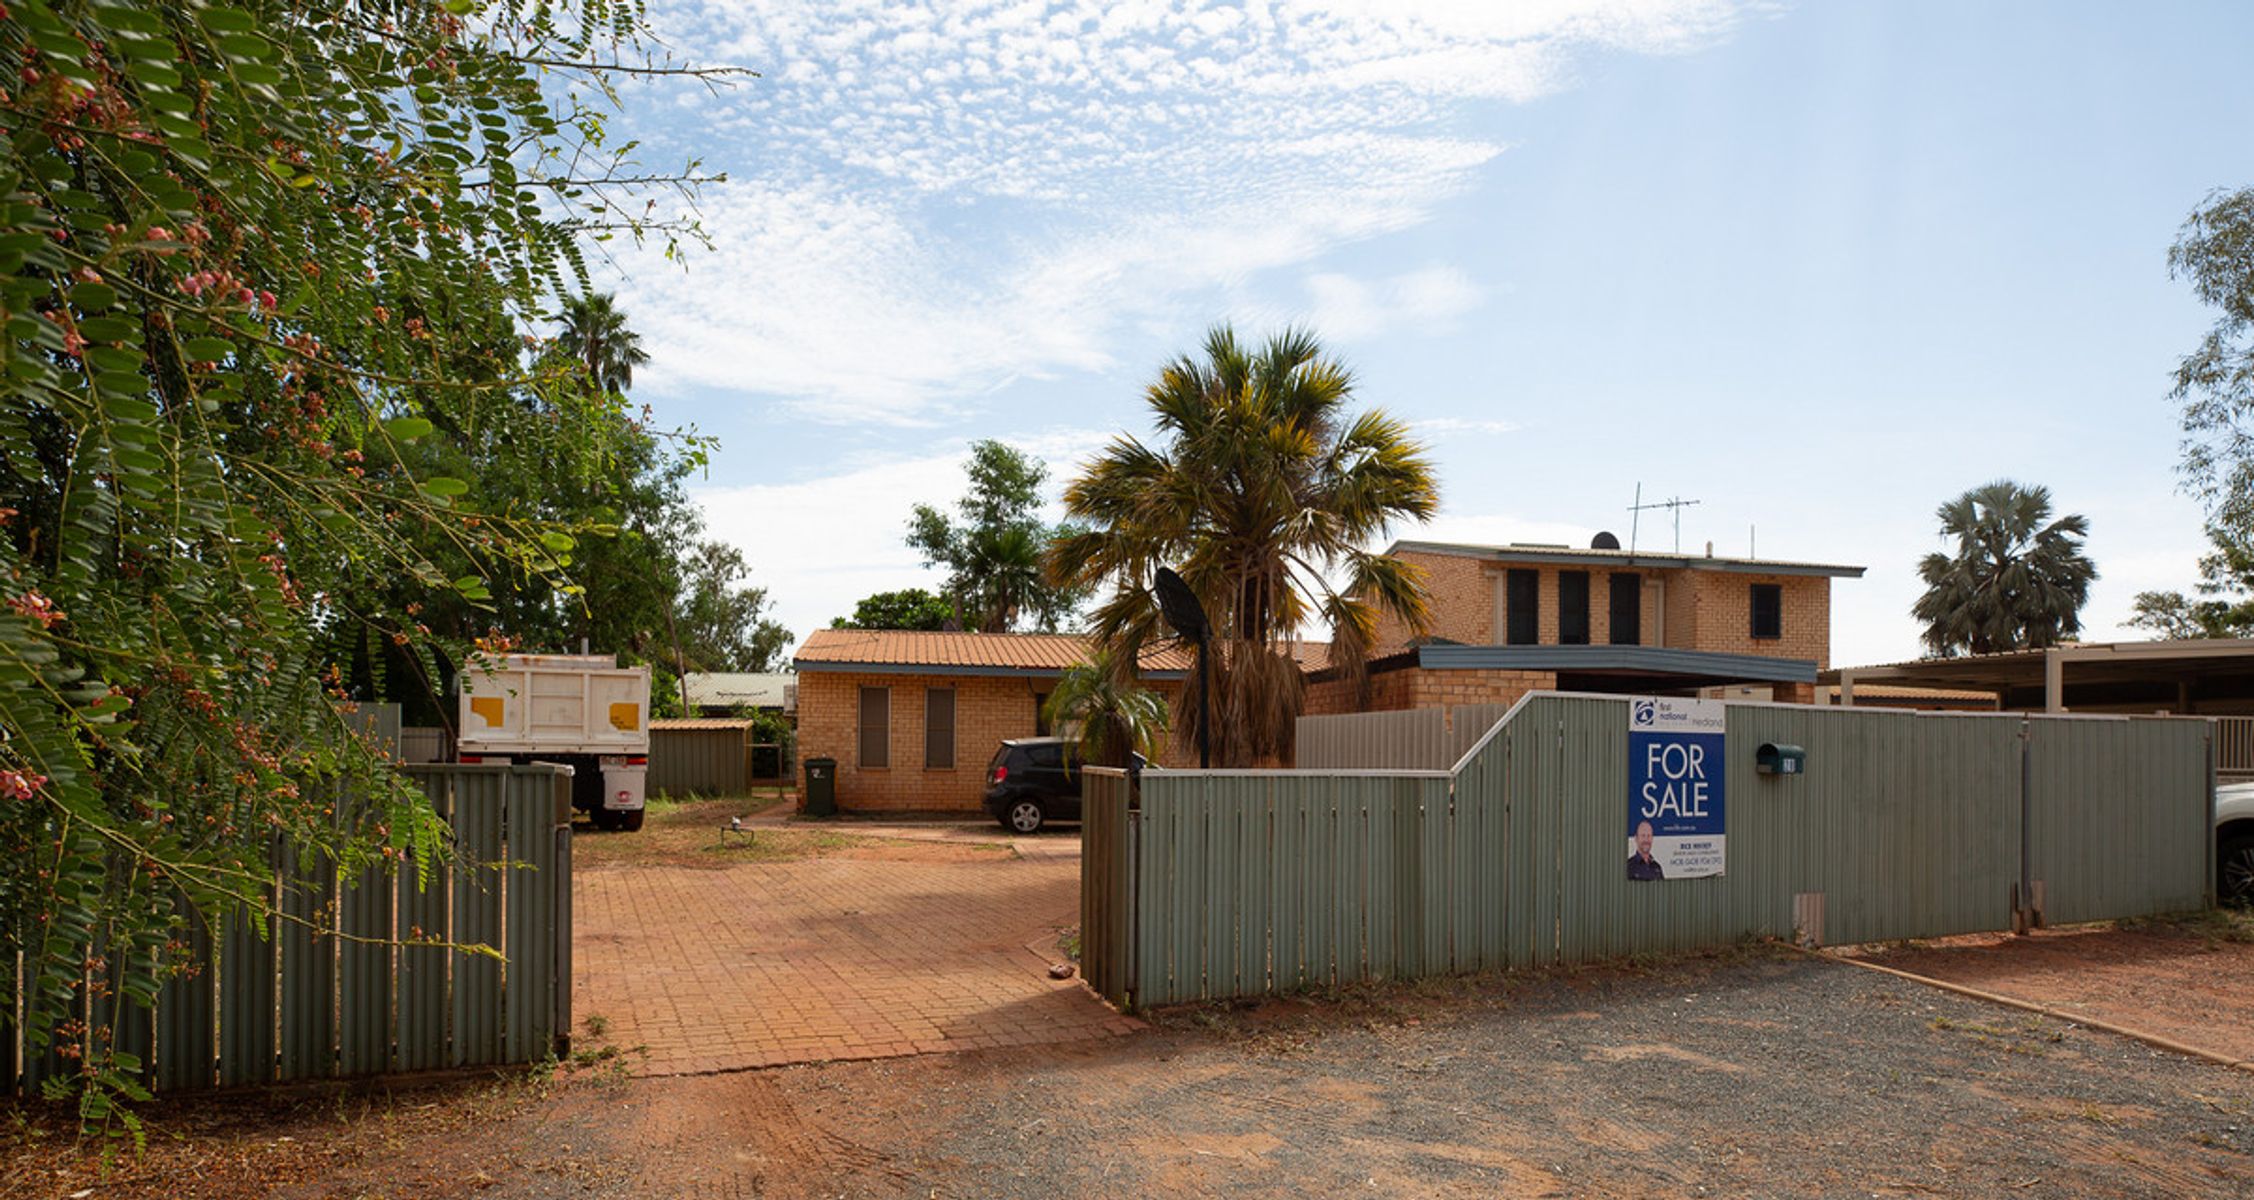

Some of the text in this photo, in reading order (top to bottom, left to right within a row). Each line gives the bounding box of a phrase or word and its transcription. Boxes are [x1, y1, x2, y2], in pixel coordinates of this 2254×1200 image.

[1659, 712, 1688, 721] national
[1648, 743, 1705, 779] FOR
[1641, 782, 1709, 818] SALE
